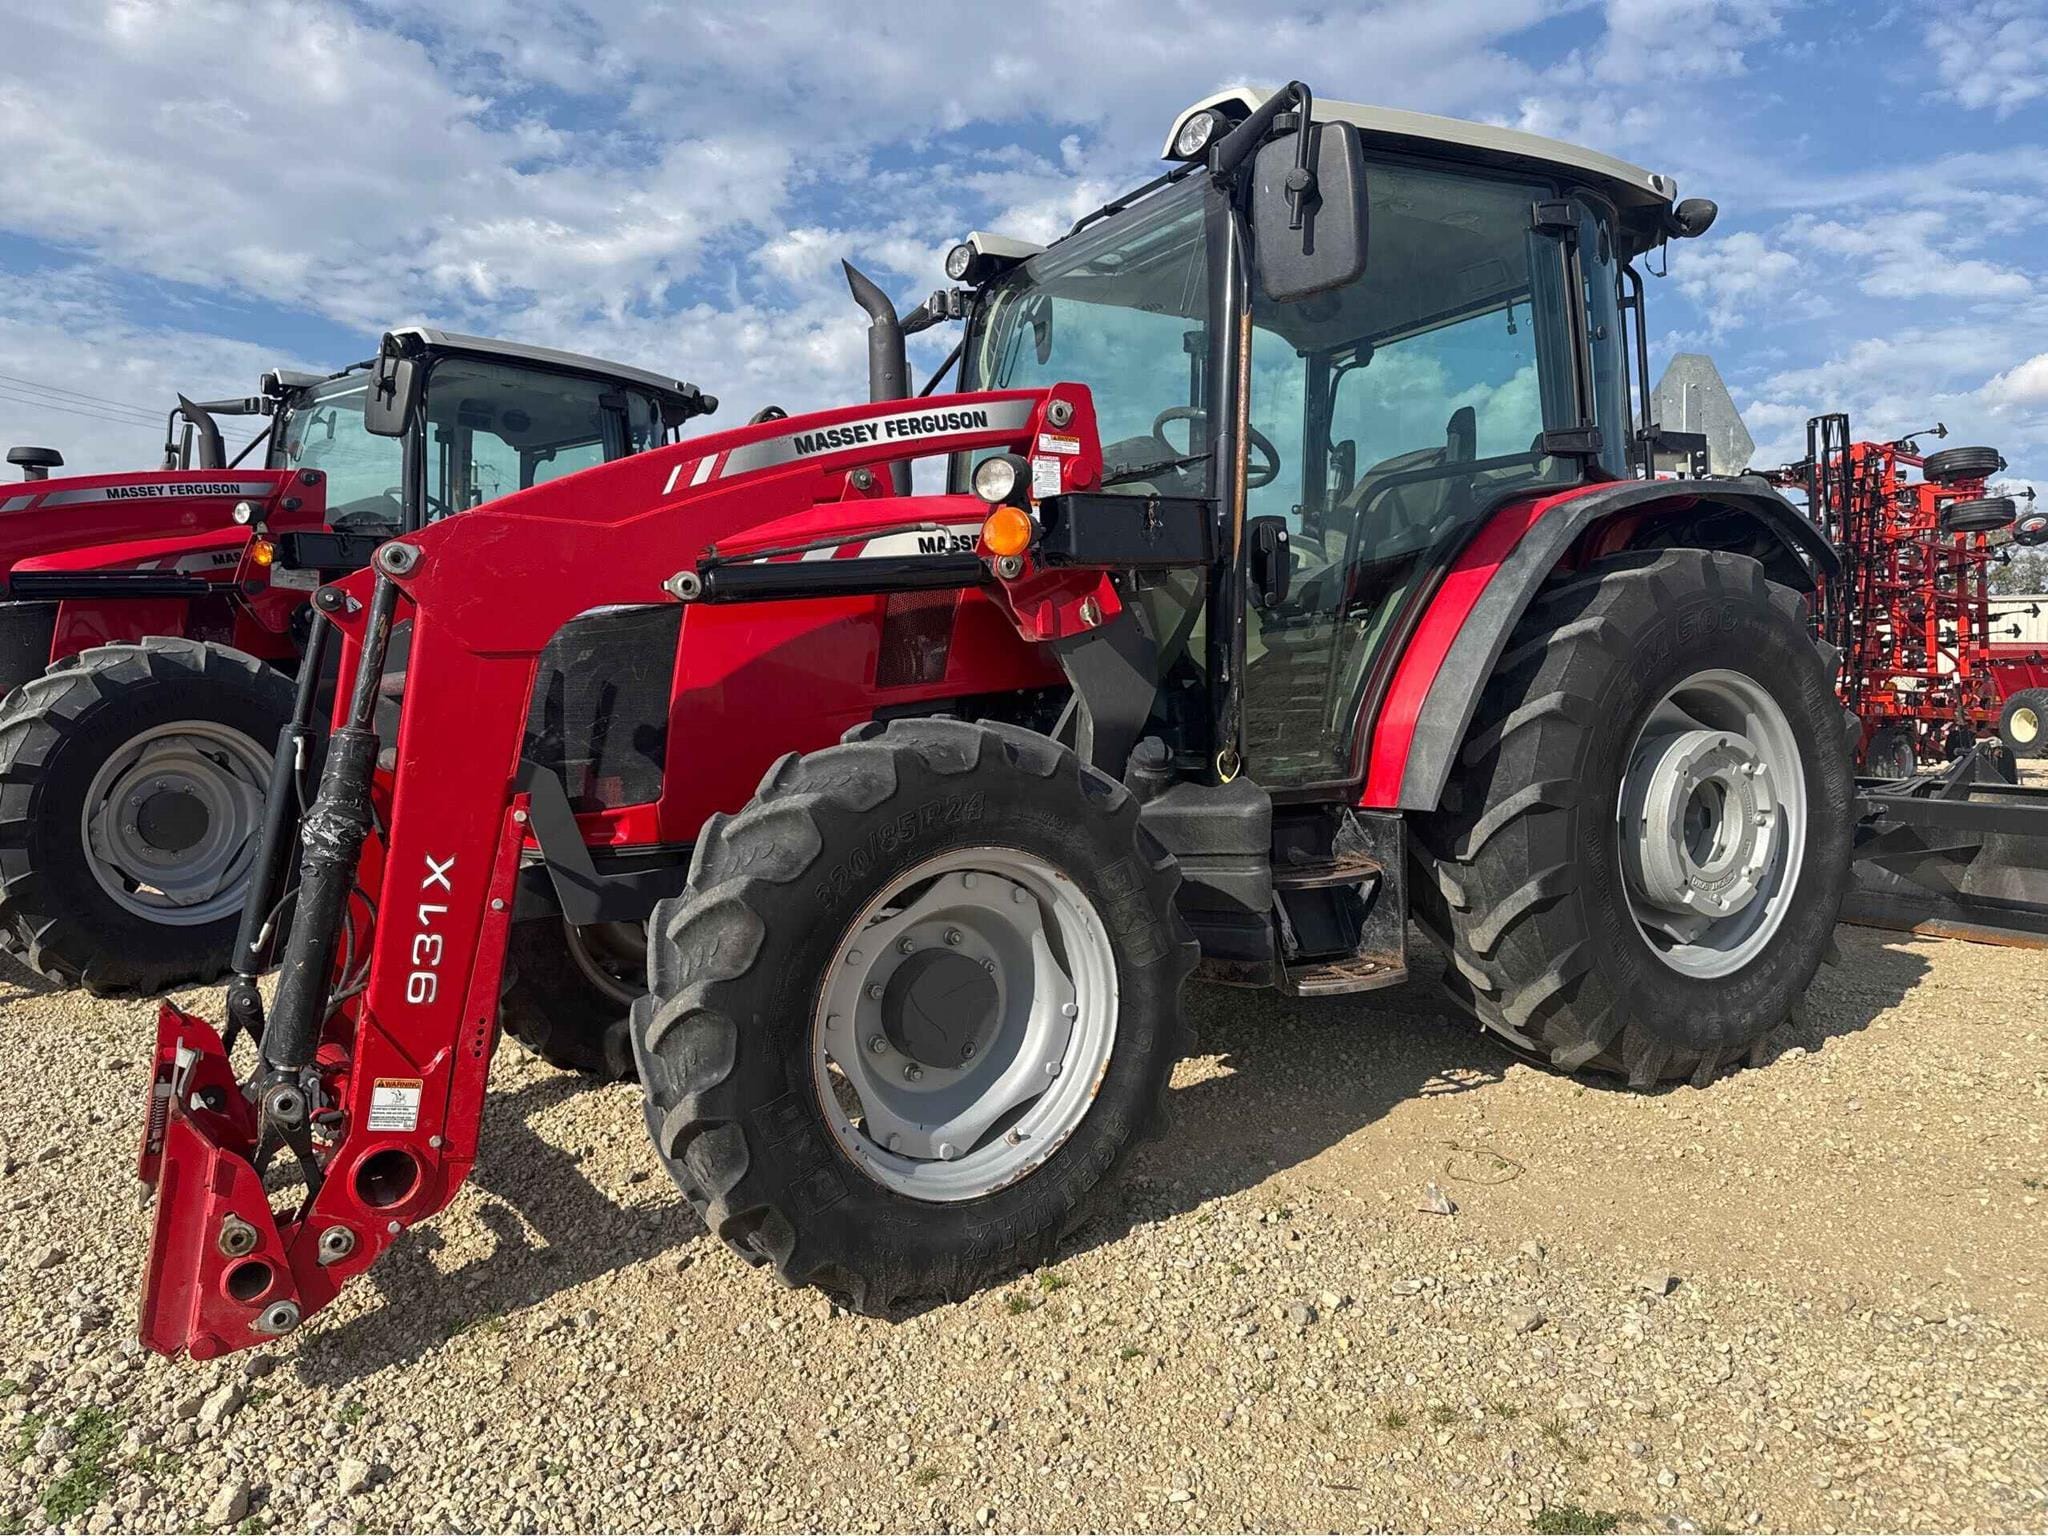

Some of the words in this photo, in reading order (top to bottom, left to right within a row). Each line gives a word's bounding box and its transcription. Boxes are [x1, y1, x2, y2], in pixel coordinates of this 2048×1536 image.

[794, 423, 879, 455] MASSEY
[885, 411, 988, 438] FERGUSON
[106, 486, 165, 499] MASSEY
[169, 484, 241, 496] FERGUSON
[385, 1080, 421, 1088] WARNING
